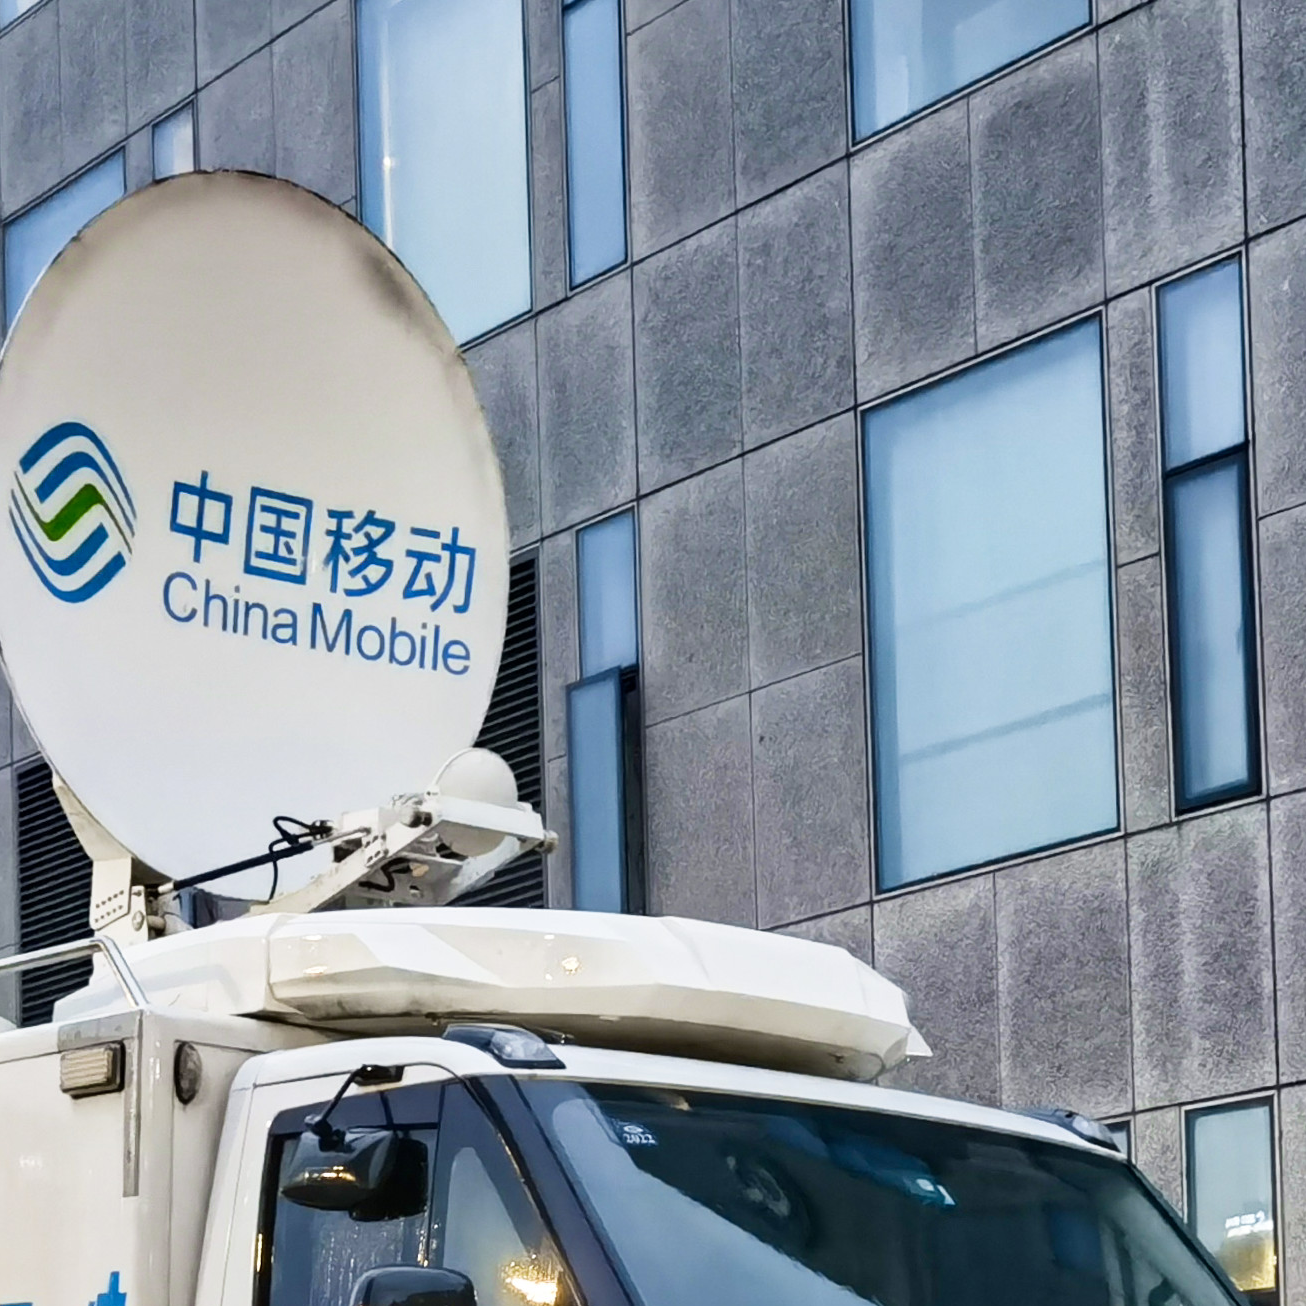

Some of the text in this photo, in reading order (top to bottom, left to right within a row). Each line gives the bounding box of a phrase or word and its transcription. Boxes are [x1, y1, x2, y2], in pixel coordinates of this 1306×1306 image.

[170, 470, 477, 614] 中国移动
[162, 571, 472, 676] China Mobile
